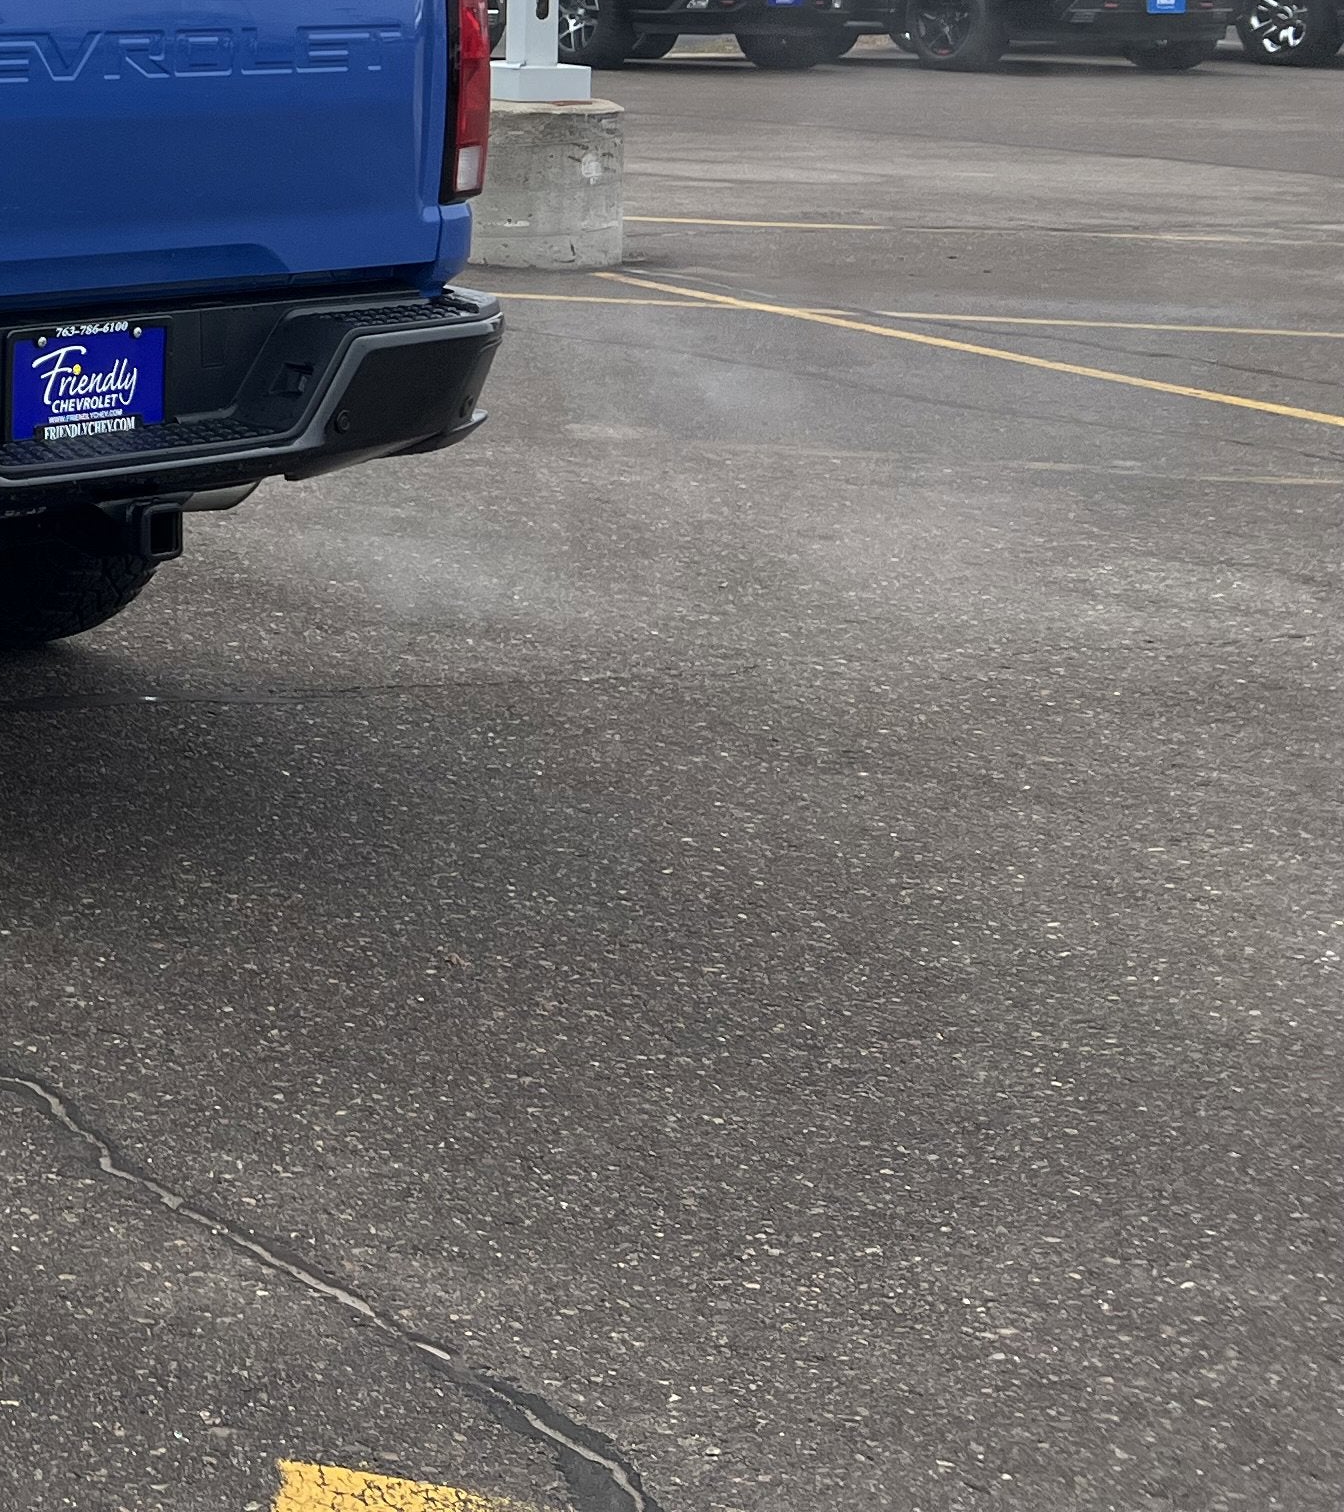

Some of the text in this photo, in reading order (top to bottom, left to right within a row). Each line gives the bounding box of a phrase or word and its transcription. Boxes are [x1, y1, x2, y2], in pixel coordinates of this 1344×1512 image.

[55, 321, 129, 338] 763-786-6100
[31, 345, 138, 406] Friendly
[51, 393, 119, 414] CHEVROLET
[44, 416, 136, 441] FRIENDLYCHEV.COM
